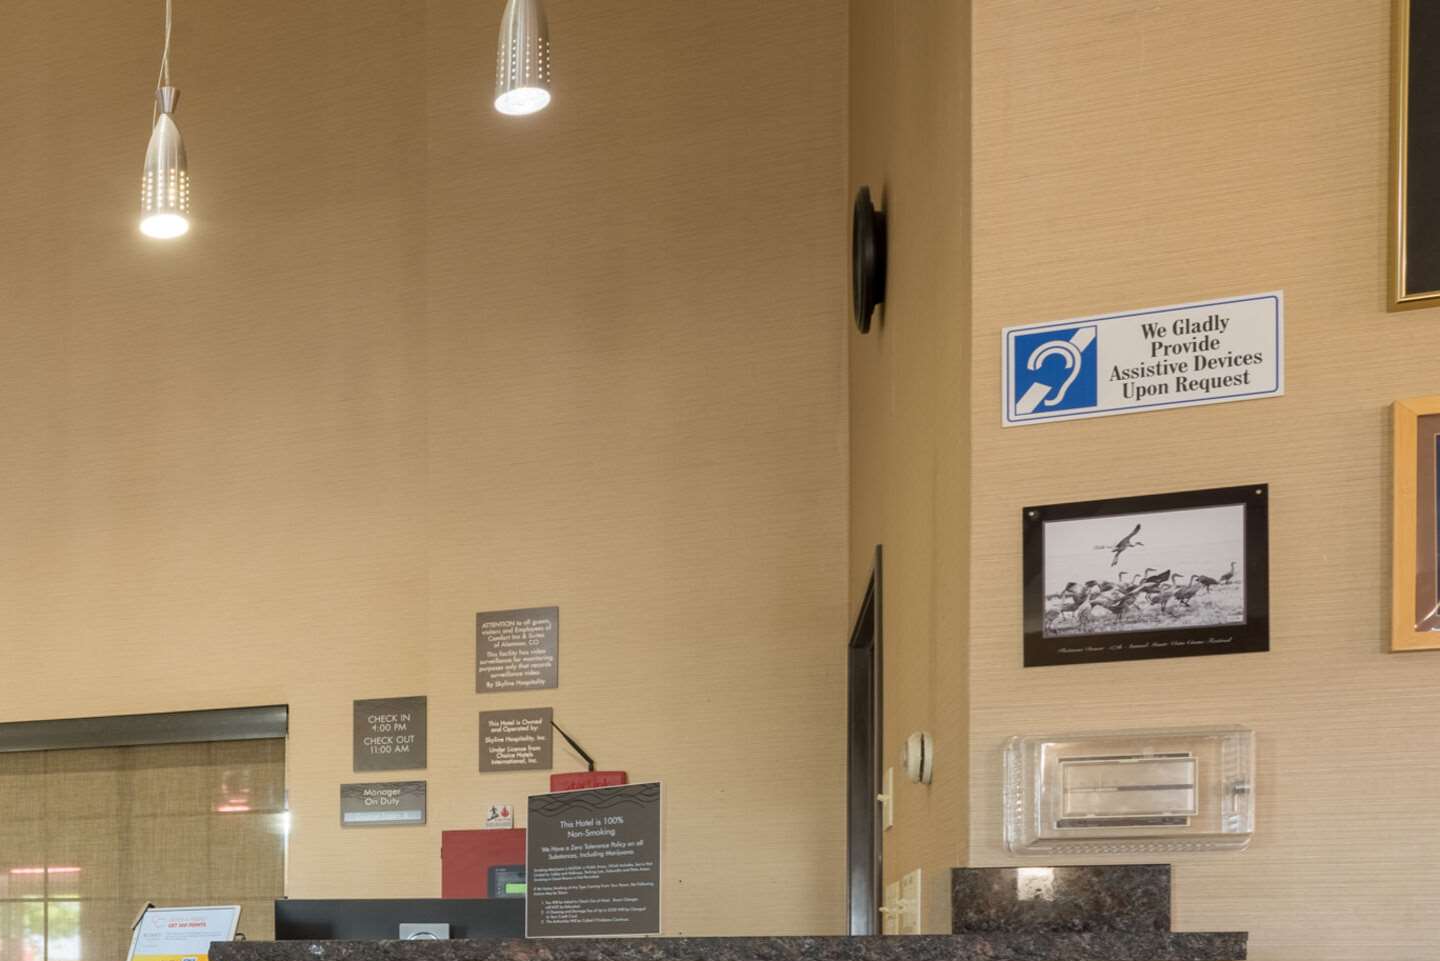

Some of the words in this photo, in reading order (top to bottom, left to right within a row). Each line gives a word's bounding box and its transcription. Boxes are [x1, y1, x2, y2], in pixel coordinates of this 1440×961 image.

[1141, 322, 1166, 340] We
[1172, 314, 1230, 336] Gladly
[1151, 335, 1220, 357] Provide
[1110, 359, 1188, 382] Assistive
[1194, 351, 1263, 371] Devices
[1123, 381, 1169, 401] Upon
[1175, 369, 1251, 393] Request
[367, 714, 398, 724] CHECK
[400, 713, 411, 721] IN
[372, 723, 392, 733] 4:00
[394, 723, 407, 732] PM
[363, 736, 393, 746] CHECK
[396, 735, 415, 744] OUT
[370, 745, 392, 755] 11:00
[394, 745, 410, 753] AM
[363, 788, 400, 797] Manager
[364, 797, 378, 806] On
[380, 796, 400, 806] Duty
[560, 820, 575, 829] This
[576, 818, 594, 828] Hotel
[595, 818, 601, 826] is
[603, 816, 624, 825] 100%
[567, 828, 615, 839] Non-Smoking
